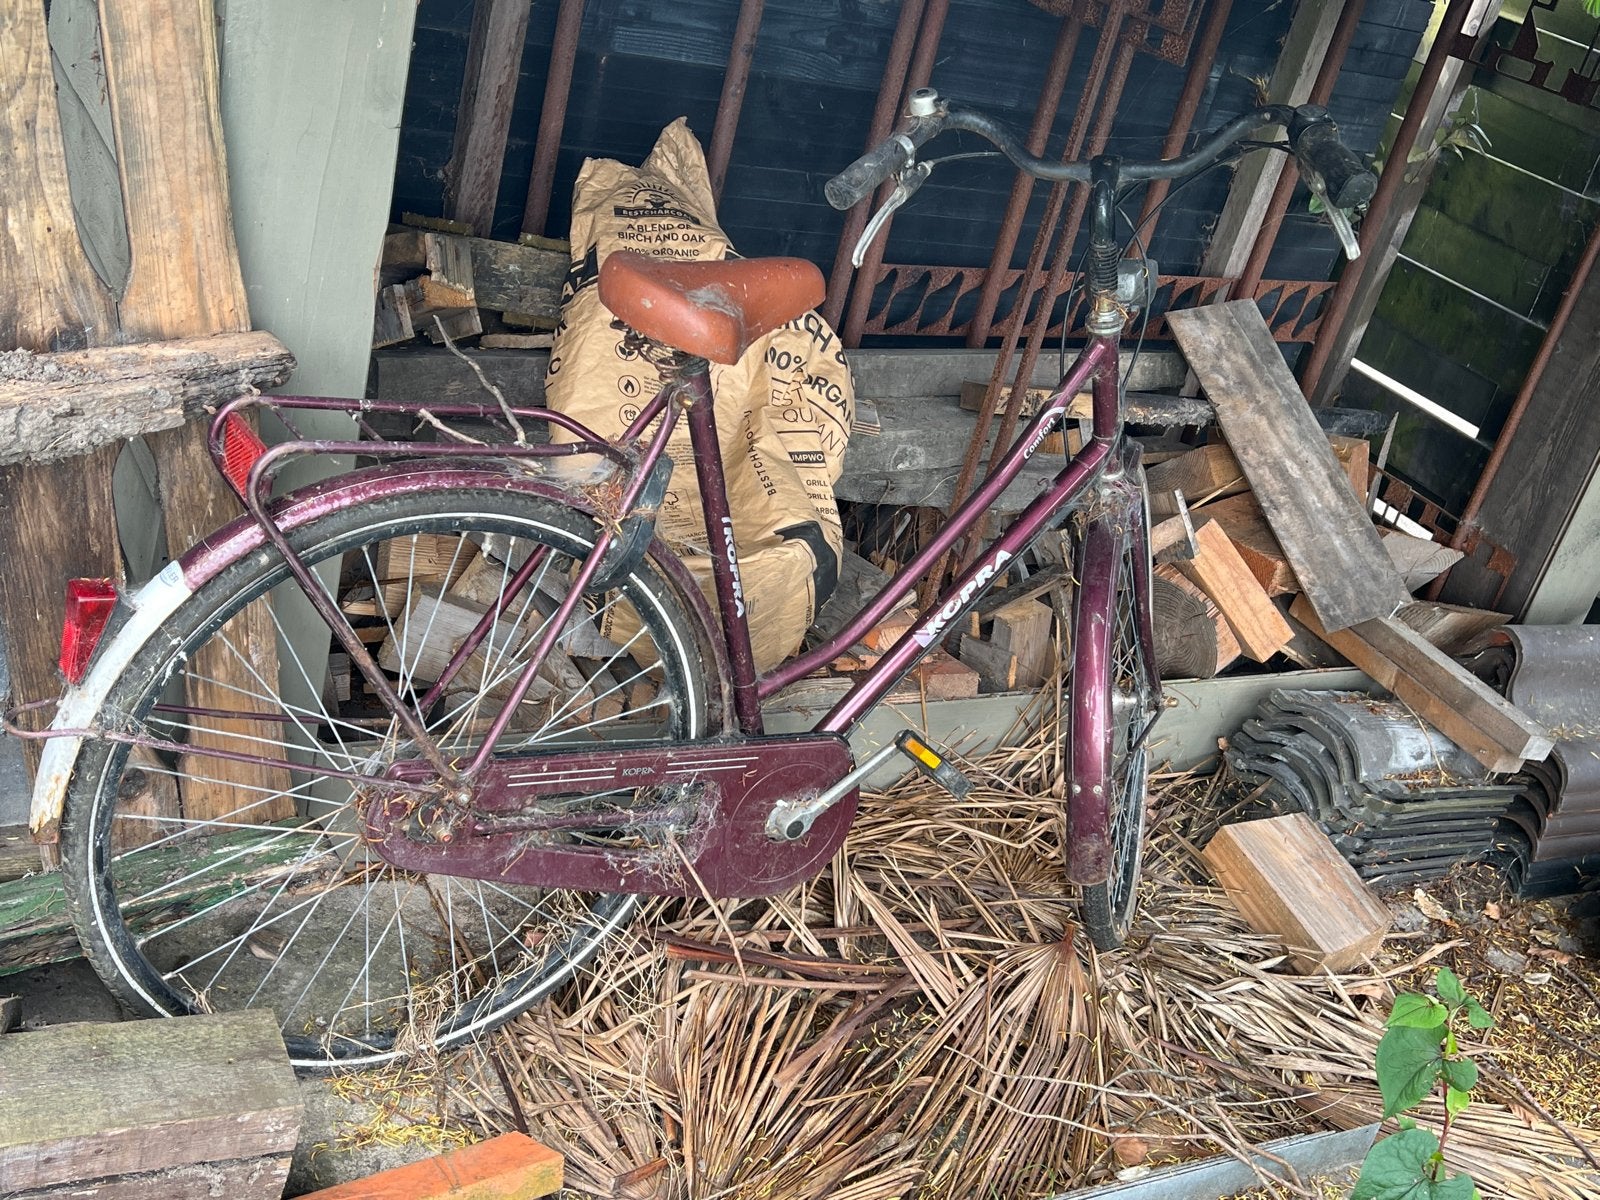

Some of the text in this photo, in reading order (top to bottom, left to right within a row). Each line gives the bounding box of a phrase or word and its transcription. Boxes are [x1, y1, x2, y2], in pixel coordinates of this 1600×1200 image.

[637, 223, 674, 233] BLEND
[618, 231, 706, 243] BIRCH AND OAK
[652, 247, 700, 257] ORGANIC
[1023, 417, 1056, 460] Comfort
[805, 479, 828, 487] GRILL
[723, 526, 745, 618] KOPRA
[926, 550, 1012, 636] KOPRA
[622, 767, 655, 776] KOPRA
